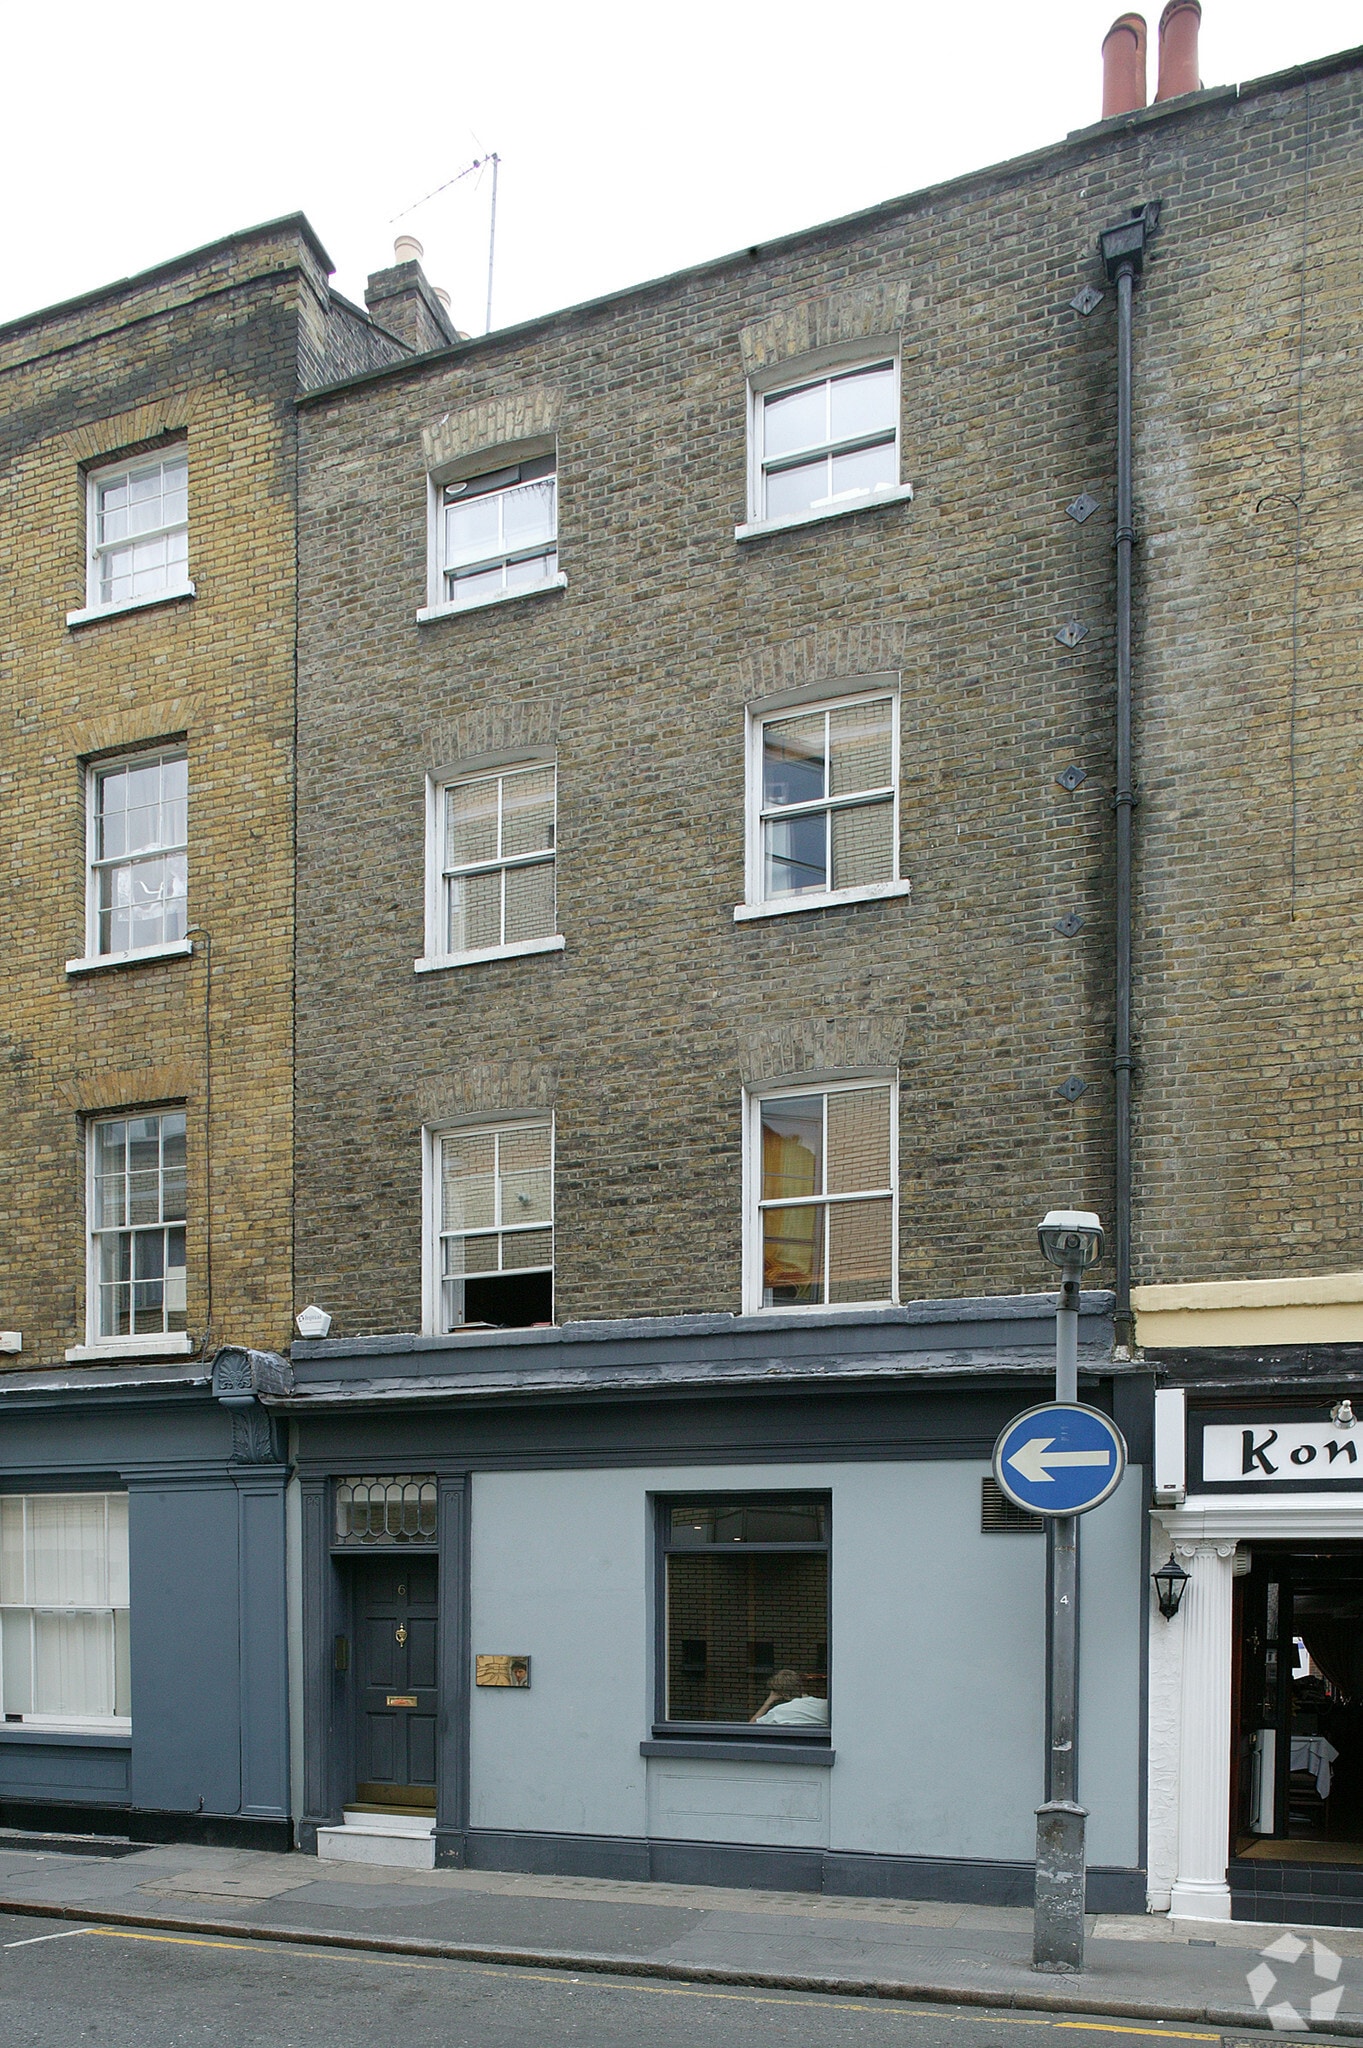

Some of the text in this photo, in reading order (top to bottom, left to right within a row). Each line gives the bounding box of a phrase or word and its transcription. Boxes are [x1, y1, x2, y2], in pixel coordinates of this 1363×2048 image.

[1241, 1429, 1358, 1475] Kon
[397, 1584, 406, 1596] 6
[1060, 1594, 1069, 1605] 4
